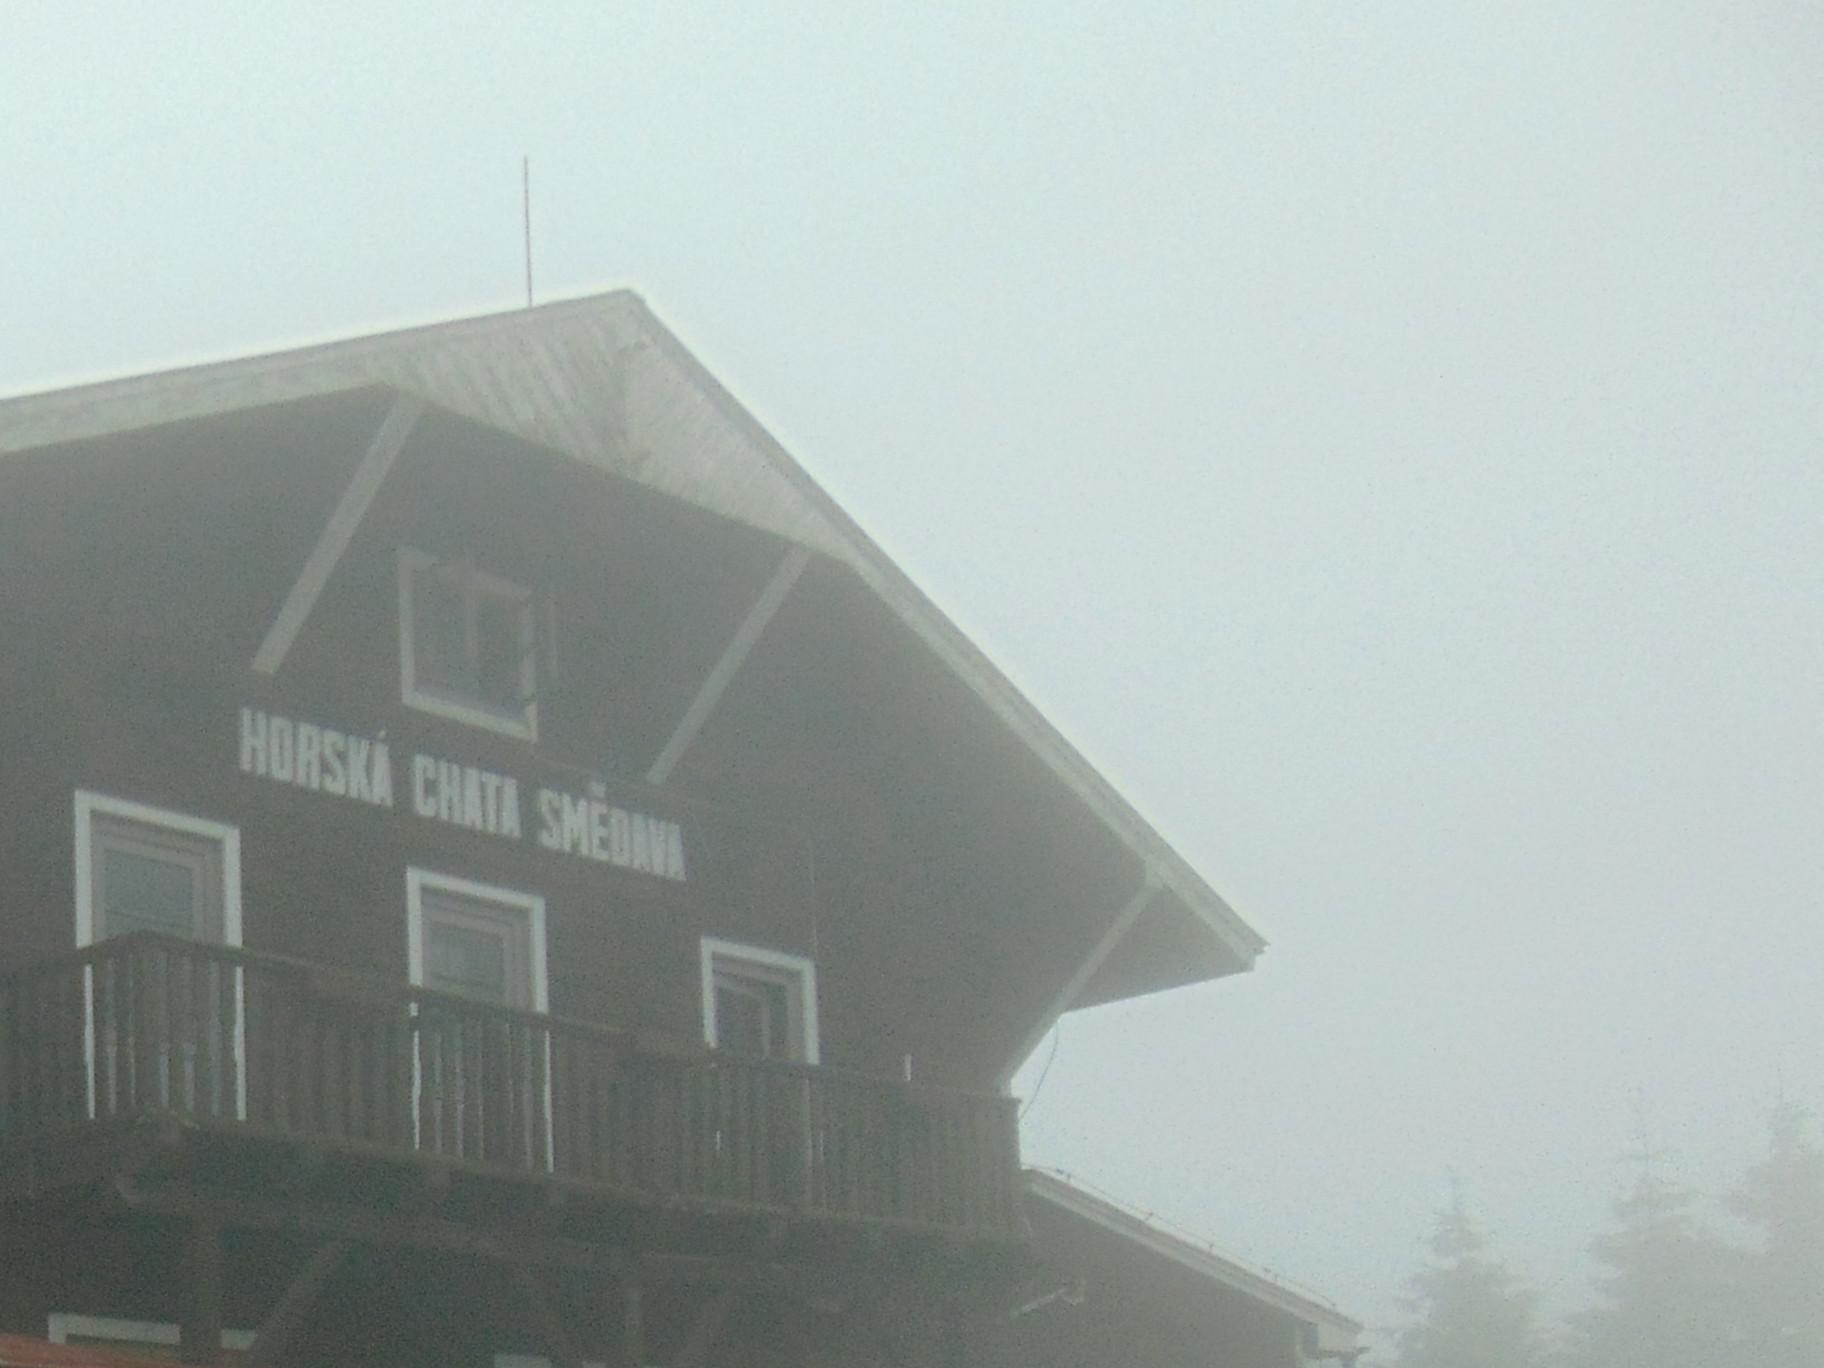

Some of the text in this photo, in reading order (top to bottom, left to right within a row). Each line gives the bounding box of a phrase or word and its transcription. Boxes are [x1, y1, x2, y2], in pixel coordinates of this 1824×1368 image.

[239, 706, 688, 883] HORSKÁ CHATA SMĚDAVA
